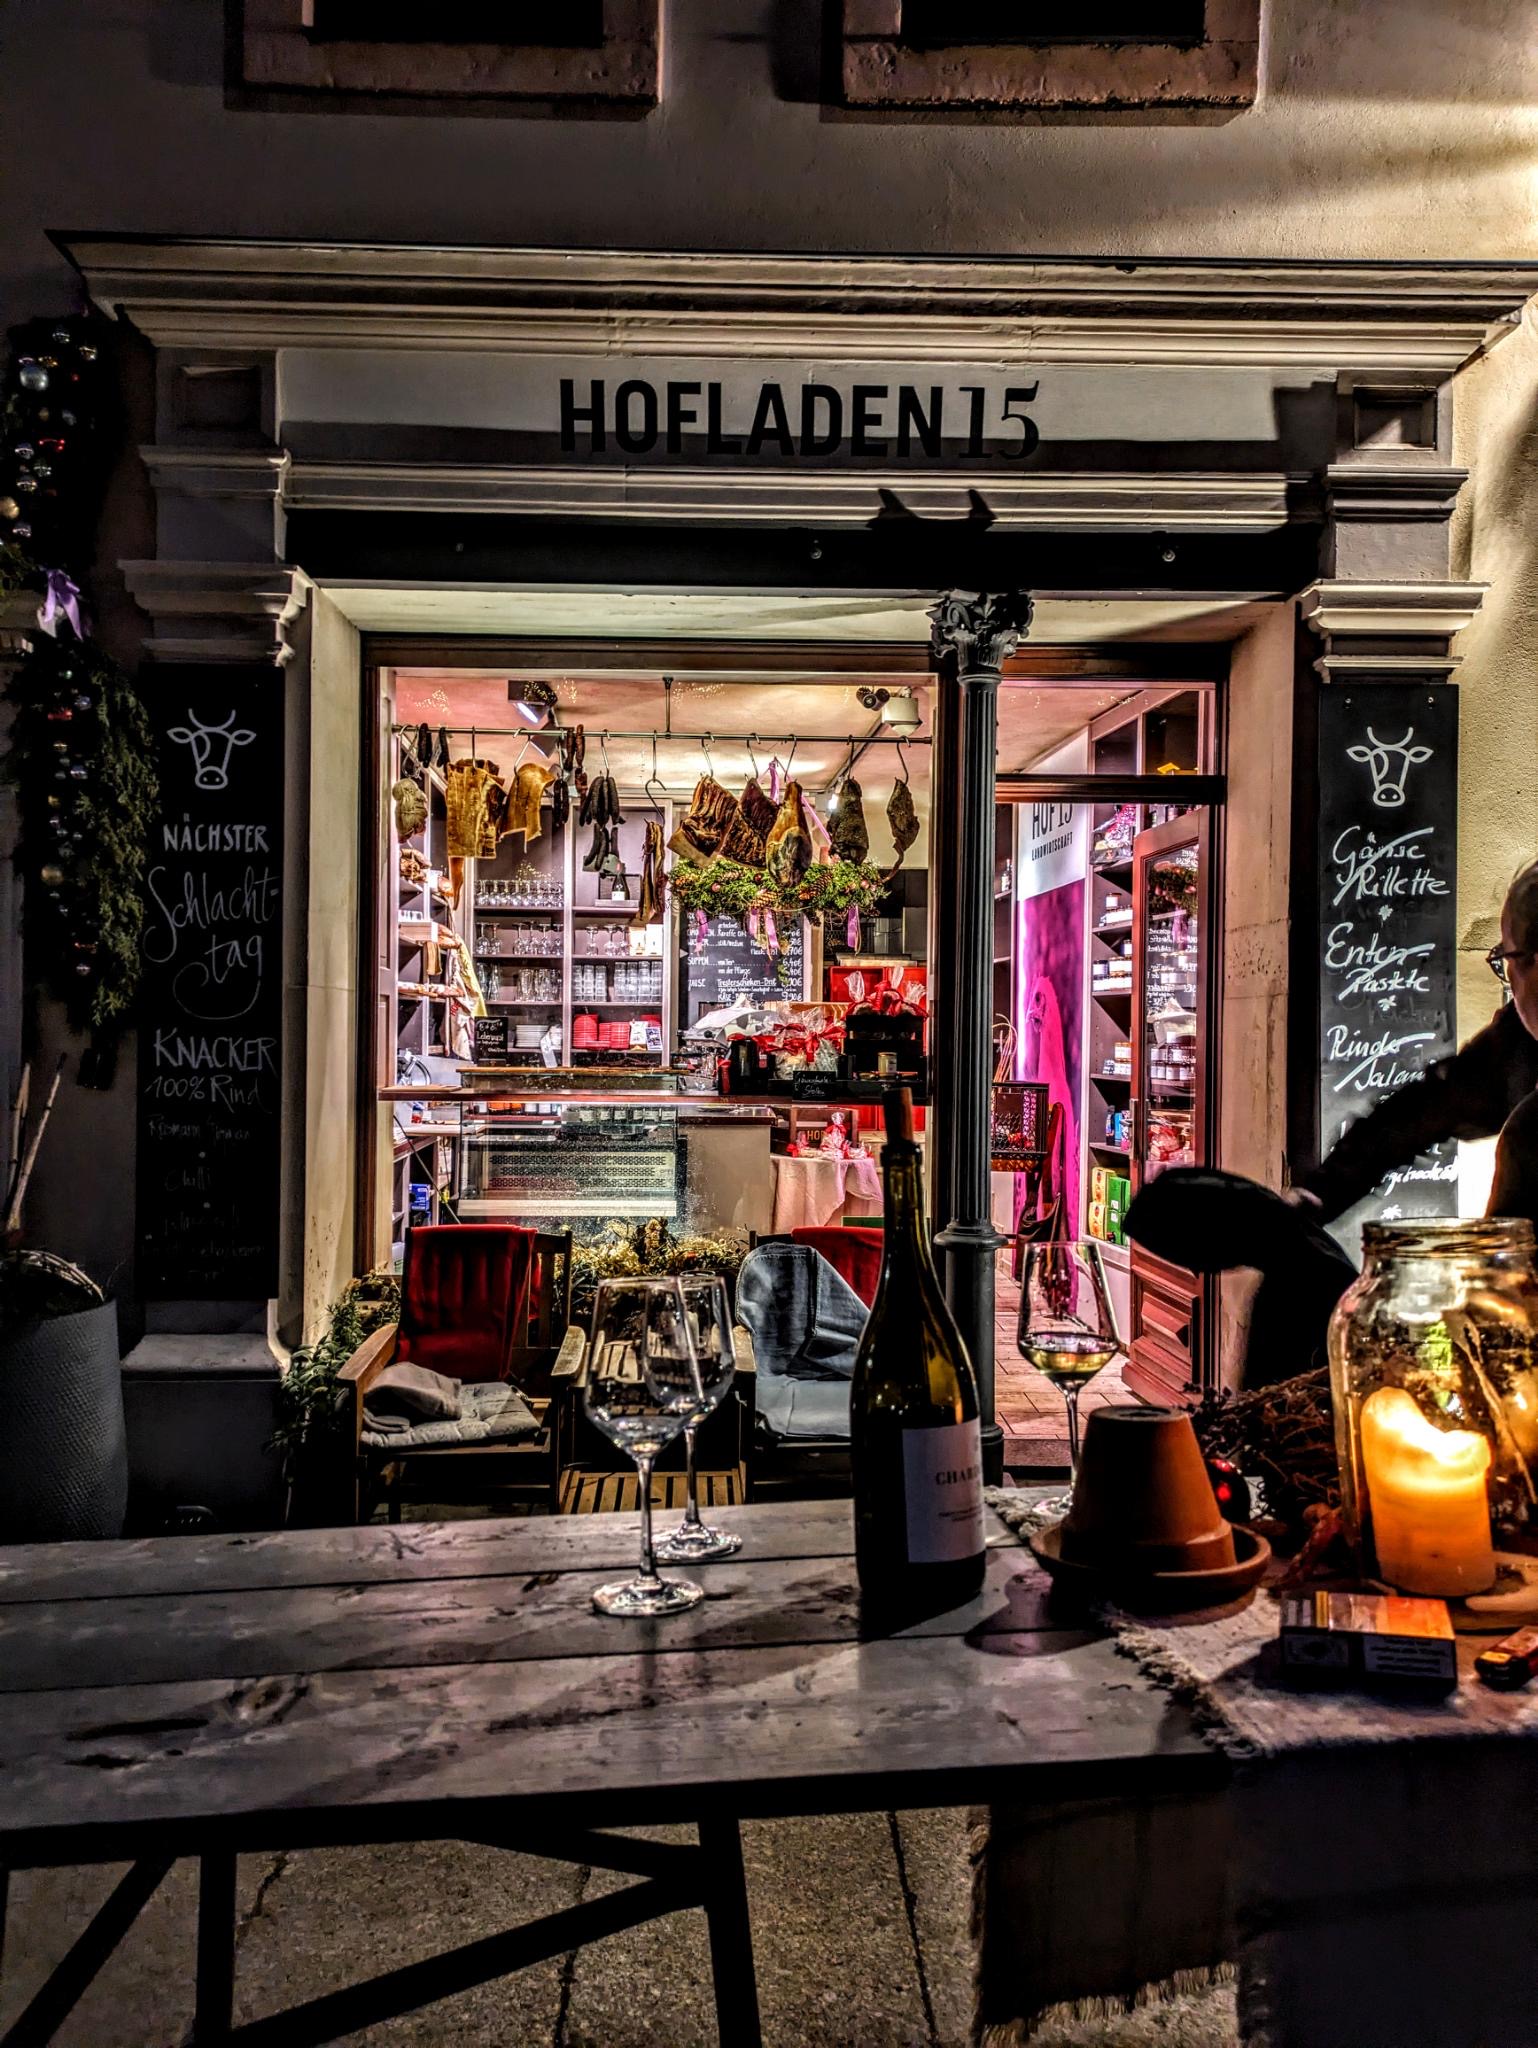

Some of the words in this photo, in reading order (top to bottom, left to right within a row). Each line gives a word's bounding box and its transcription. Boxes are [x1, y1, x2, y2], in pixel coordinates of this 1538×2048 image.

[559, 379, 1040, 461] HOFLADEN15
[163, 813, 269, 852] NÄCHSTER
[153, 1027, 280, 1079] KNACKER
[144, 1076, 206, 1101] 100%
[209, 1074, 272, 1114] Rind
[1354, 1058, 1437, 1091] Salam
